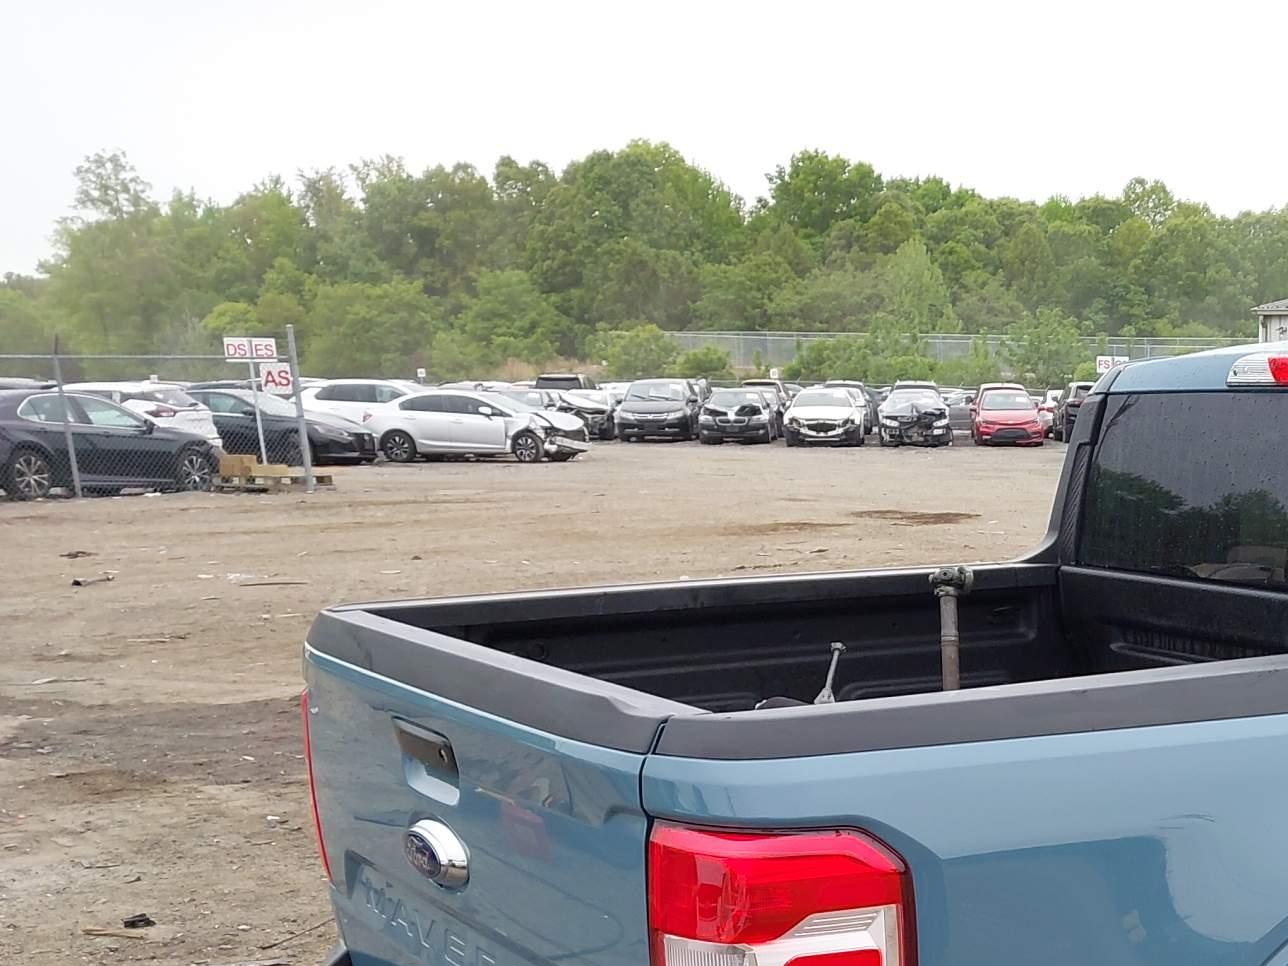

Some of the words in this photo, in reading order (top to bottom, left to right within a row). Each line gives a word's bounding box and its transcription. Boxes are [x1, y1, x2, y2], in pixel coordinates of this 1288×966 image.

[226, 343, 248, 357] DS
[254, 343, 275, 357] ES
[1098, 359, 1111, 370] FS
[264, 369, 291, 387] AS
